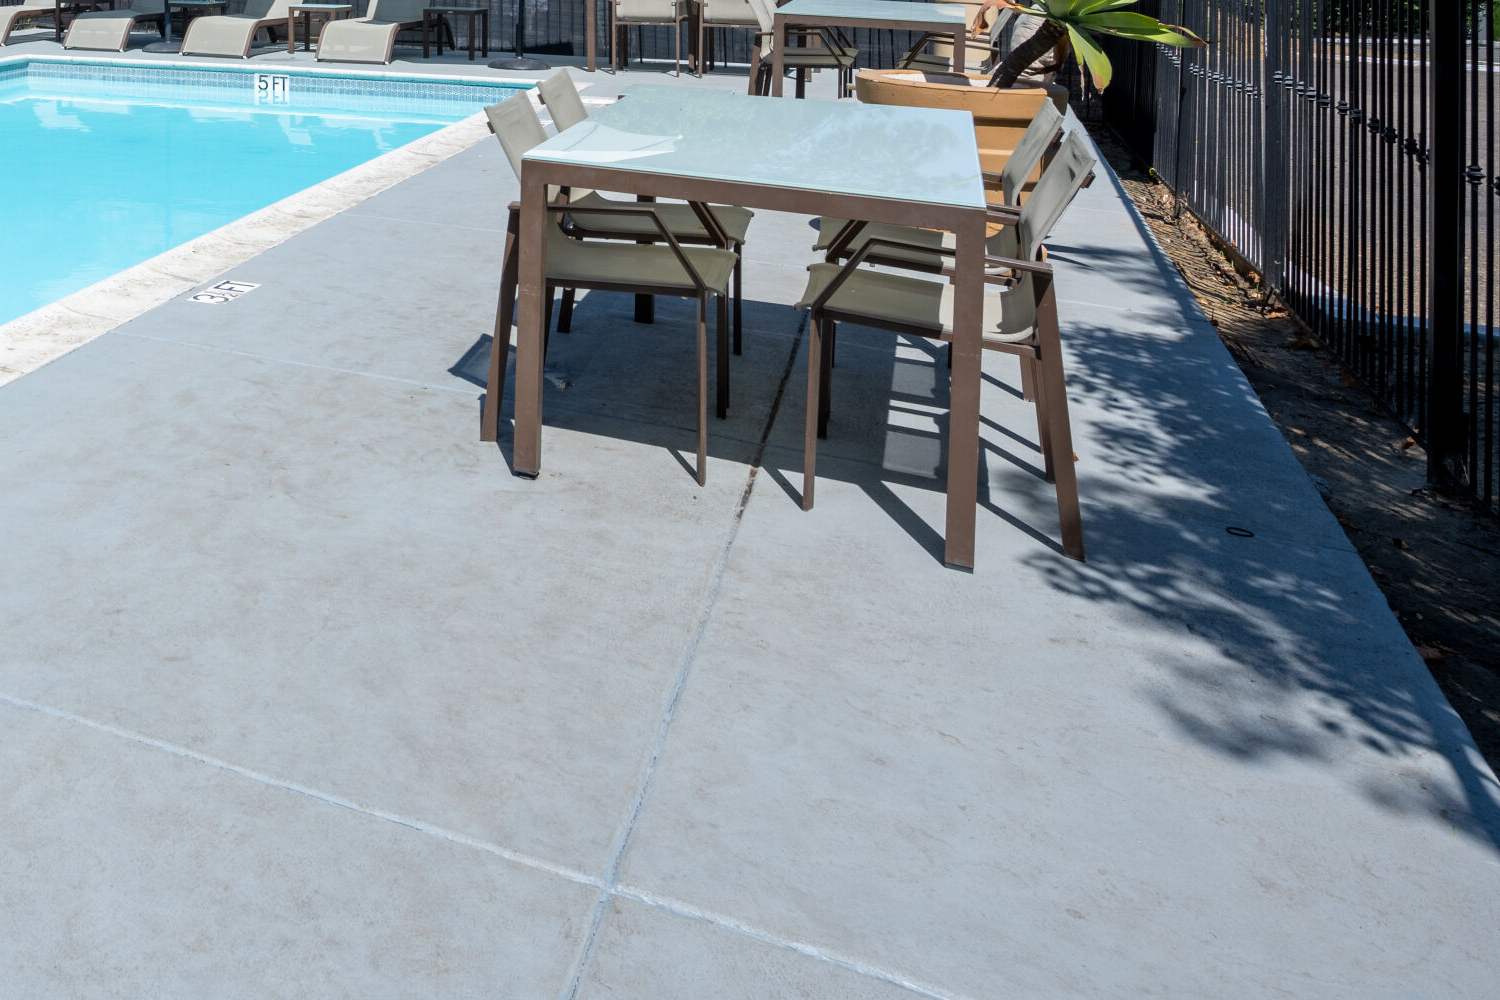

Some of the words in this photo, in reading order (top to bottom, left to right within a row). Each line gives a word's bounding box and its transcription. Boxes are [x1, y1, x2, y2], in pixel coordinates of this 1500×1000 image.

[258, 75, 268, 90] 5
[273, 76, 288, 91] FT
[213, 281, 255, 292] FT
